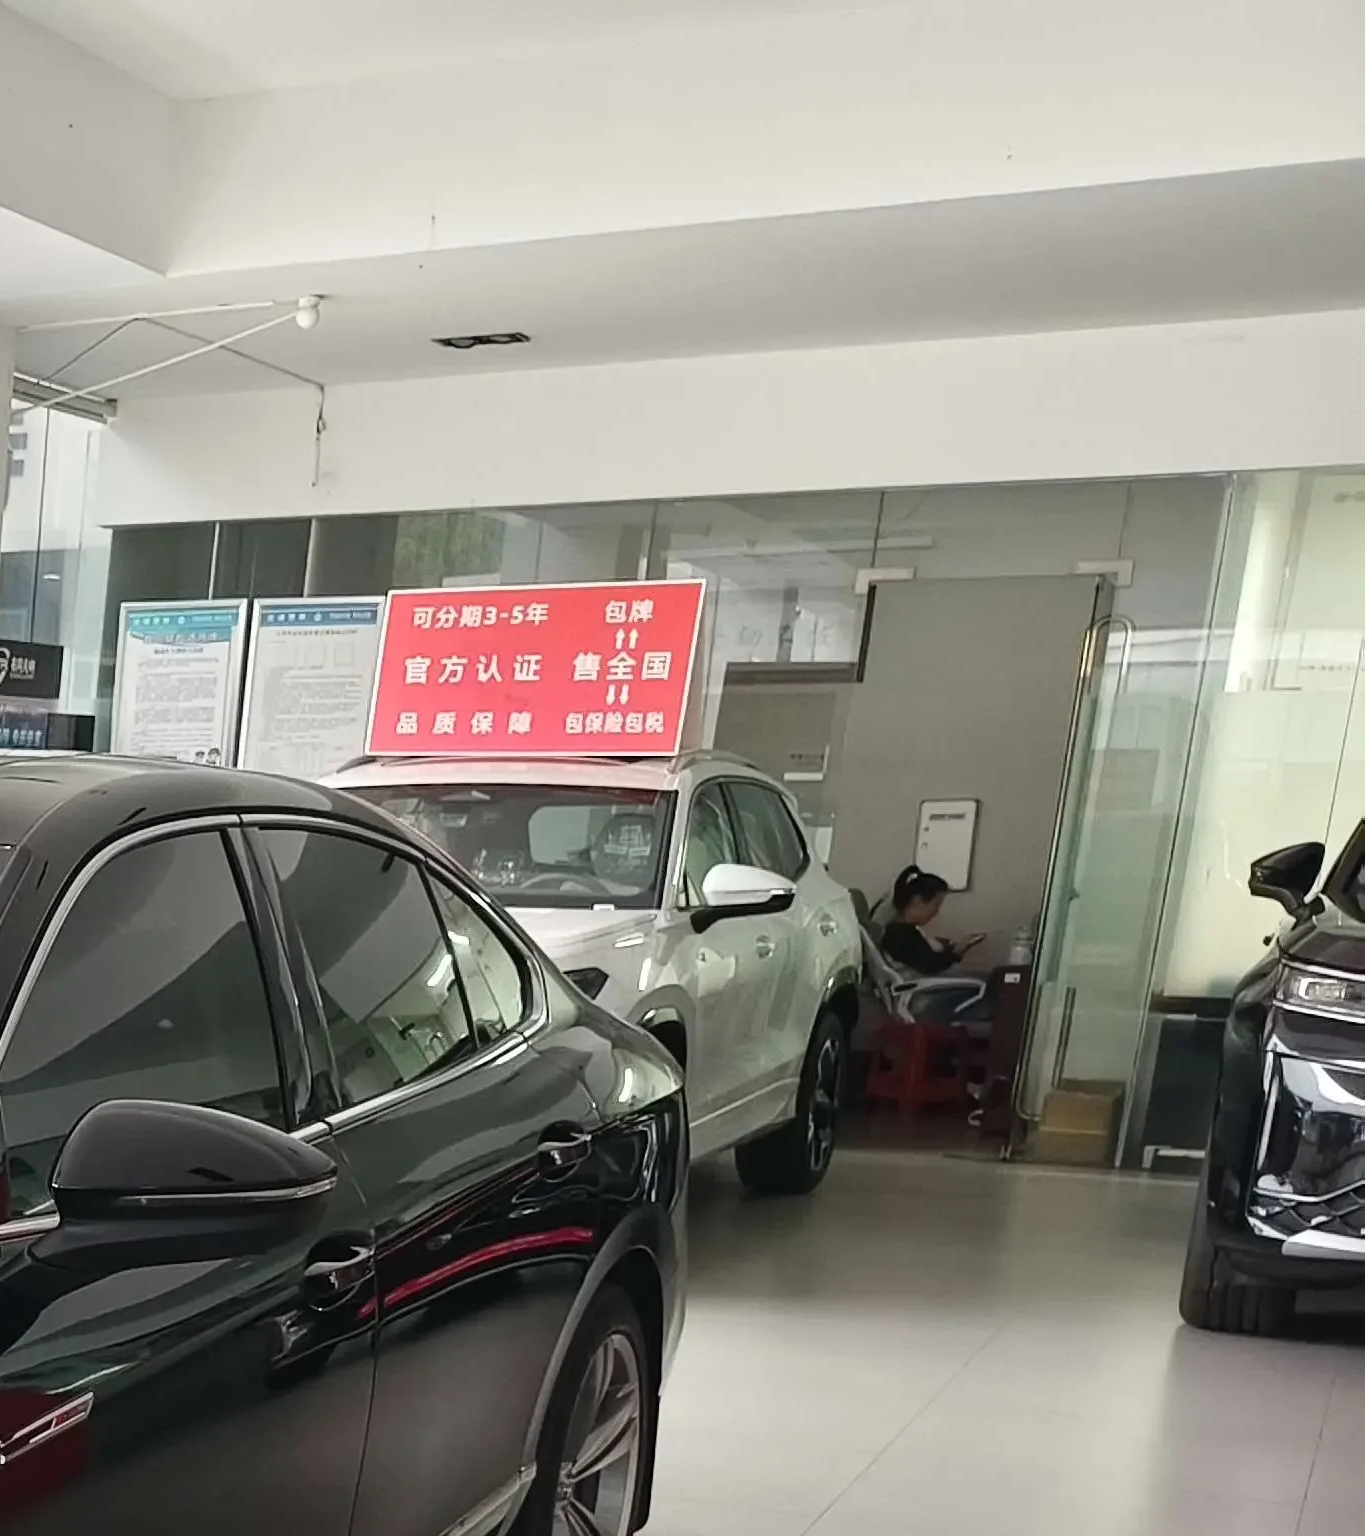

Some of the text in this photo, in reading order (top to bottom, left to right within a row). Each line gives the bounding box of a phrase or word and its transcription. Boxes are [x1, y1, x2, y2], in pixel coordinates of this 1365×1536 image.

[412, 602, 550, 628] 可分期3-5年
[605, 600, 654, 624] 包牌
[404, 654, 543, 684] 官方认证
[572, 651, 672, 681] 售全国
[396, 711, 532, 735] 品质保障
[565, 711, 665, 735] 包保险包税
